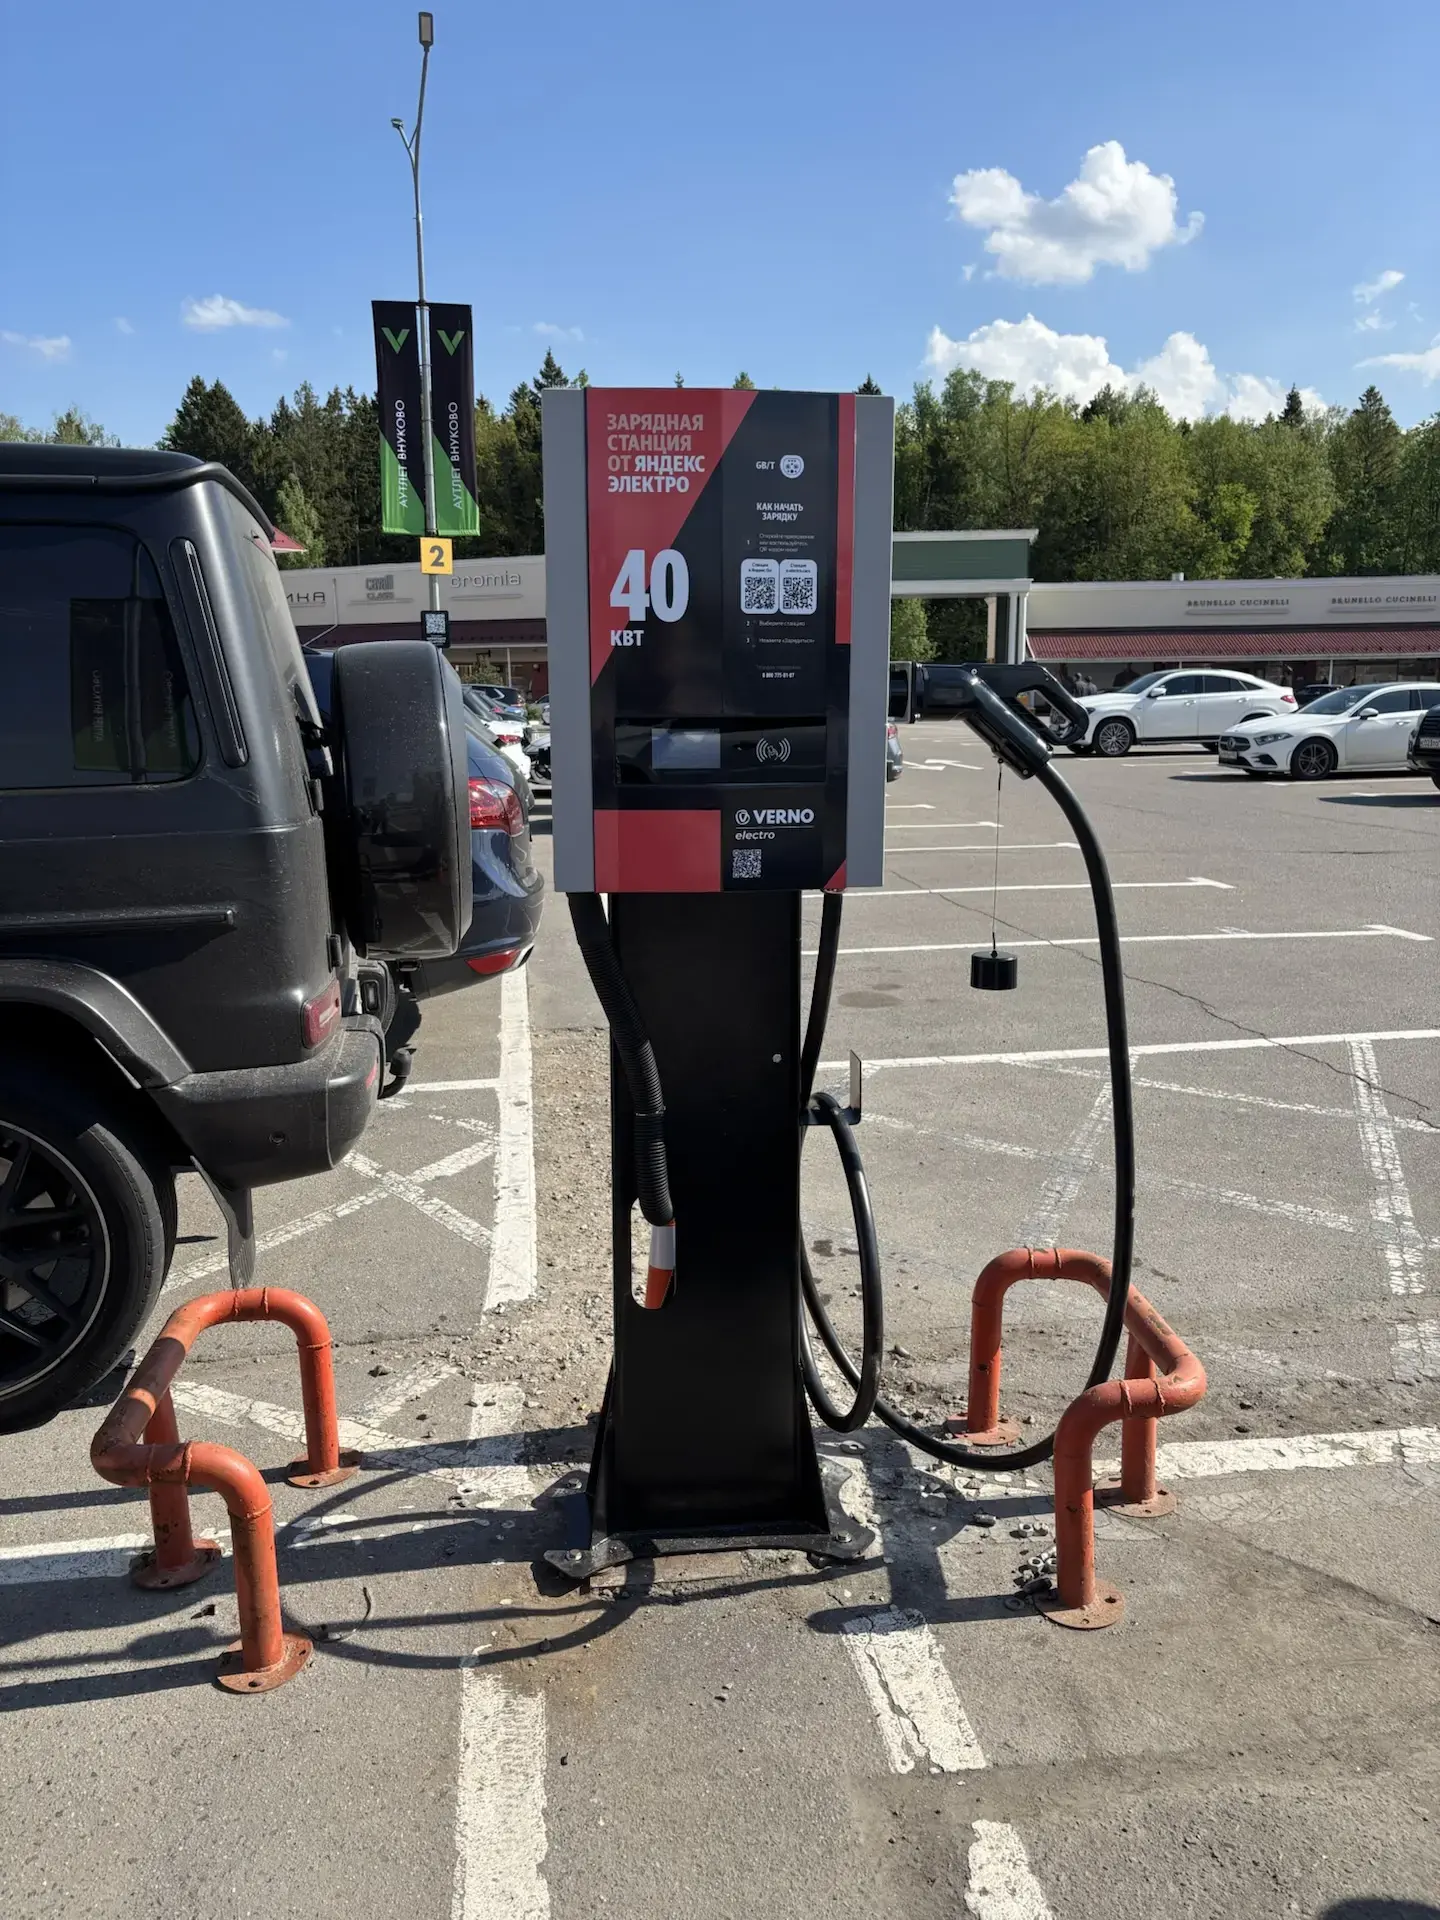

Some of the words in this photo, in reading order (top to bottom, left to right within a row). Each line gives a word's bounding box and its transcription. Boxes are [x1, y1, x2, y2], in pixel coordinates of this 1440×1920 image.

[395, 399, 407, 460] ВНУКОВО
[448, 401, 460, 462] ВНУКОВО
[607, 413, 704, 433] ЗАРЯДНАЯ
[607, 434, 692, 453] СТАНЦИЯ
[607, 455, 631, 473] ОТ
[634, 455, 705, 476] ЯНДЕКС
[755, 460, 776, 471] GB/T
[398, 466, 409, 508] АУТЛЕТ
[452, 467, 463, 510] АУТЛЕТ
[607, 475, 690, 493] ЭЛЕКТРО
[756, 502, 773, 511] КАК
[773, 502, 804, 512] НАЧАТЬ
[761, 512, 798, 522] ЗАРЯДКУ
[429, 545, 445, 567] 2
[450, 570, 521, 588] cromia
[609, 549, 690, 622] 40
[1187, 599, 1236, 607] BRUNELLO
[1239, 598, 1290, 606] CUCINELLI
[1331, 597, 1381, 605] BRUNELLO
[1385, 595, 1437, 603] CUCINELLI
[610, 629, 645, 647] КВТ
[753, 808, 815, 824] VERNO
[735, 830, 775, 840] electro
